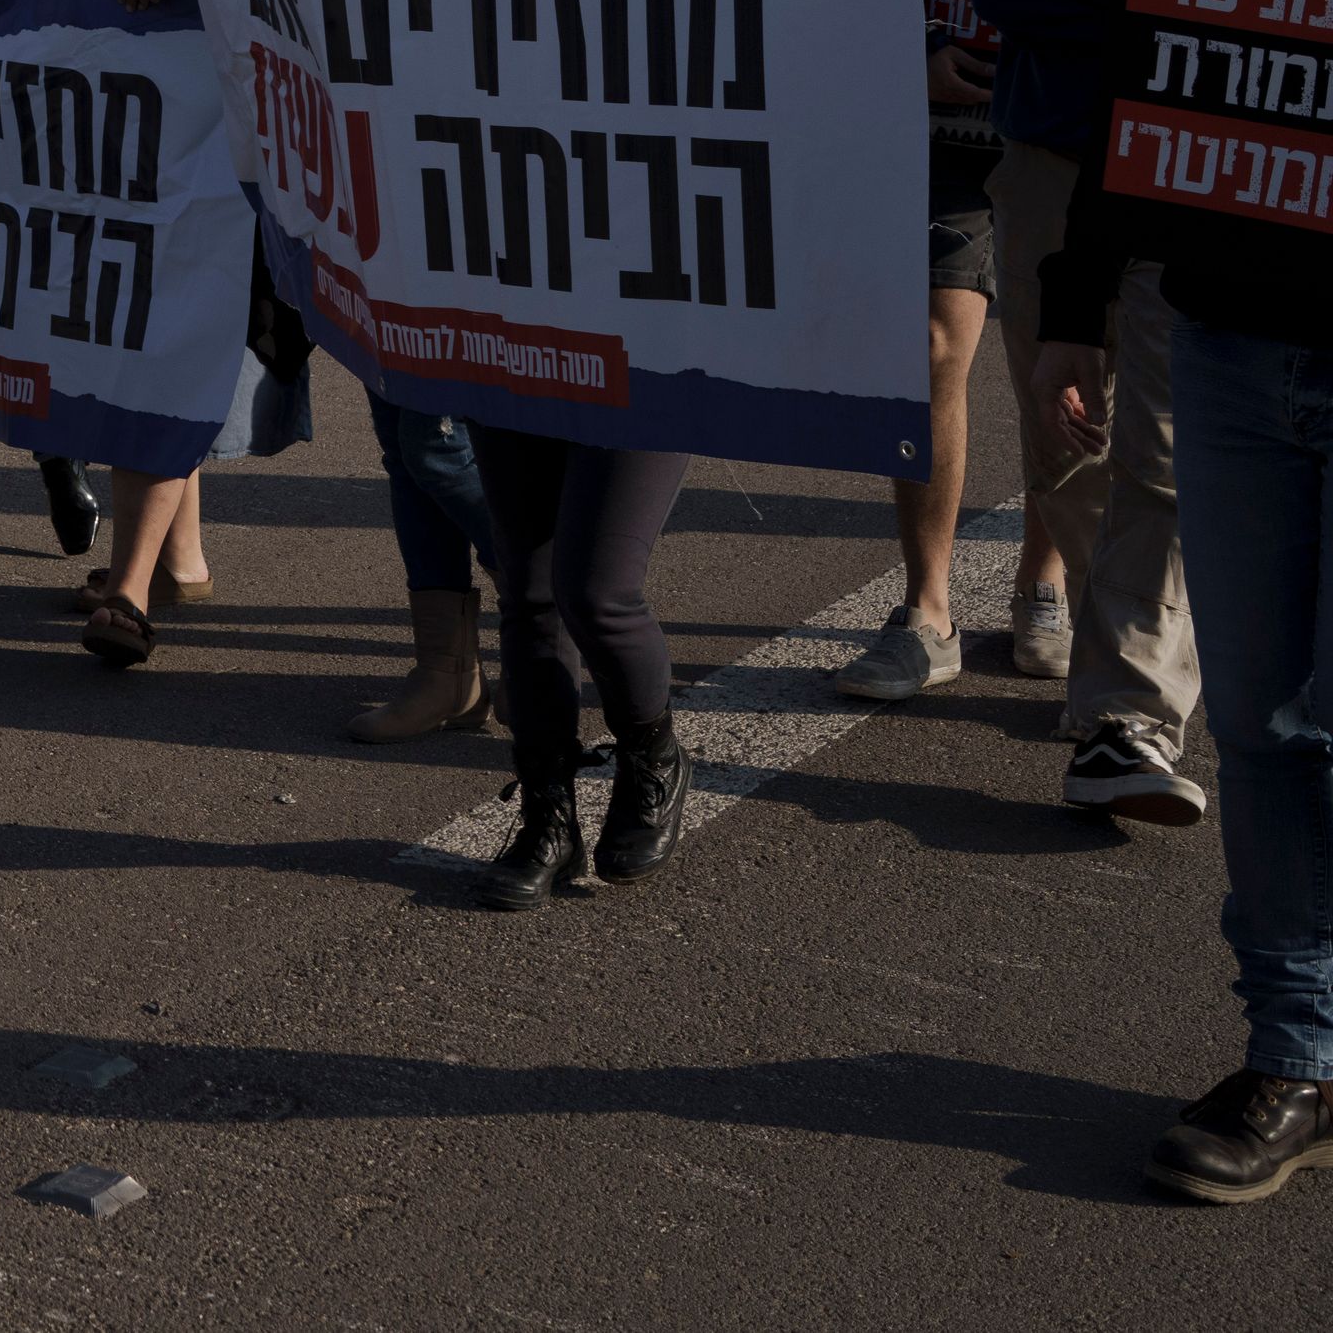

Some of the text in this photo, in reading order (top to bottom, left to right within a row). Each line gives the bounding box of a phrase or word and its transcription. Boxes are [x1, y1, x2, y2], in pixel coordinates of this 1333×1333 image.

[1117, 120, 1333, 219] ומניטרי
[415, 114, 777, 309] הביתה
[380, 320, 455, 361] להחזרת
[461, 328, 558, 380] המשפחות
[560, 350, 606, 389] מטה
